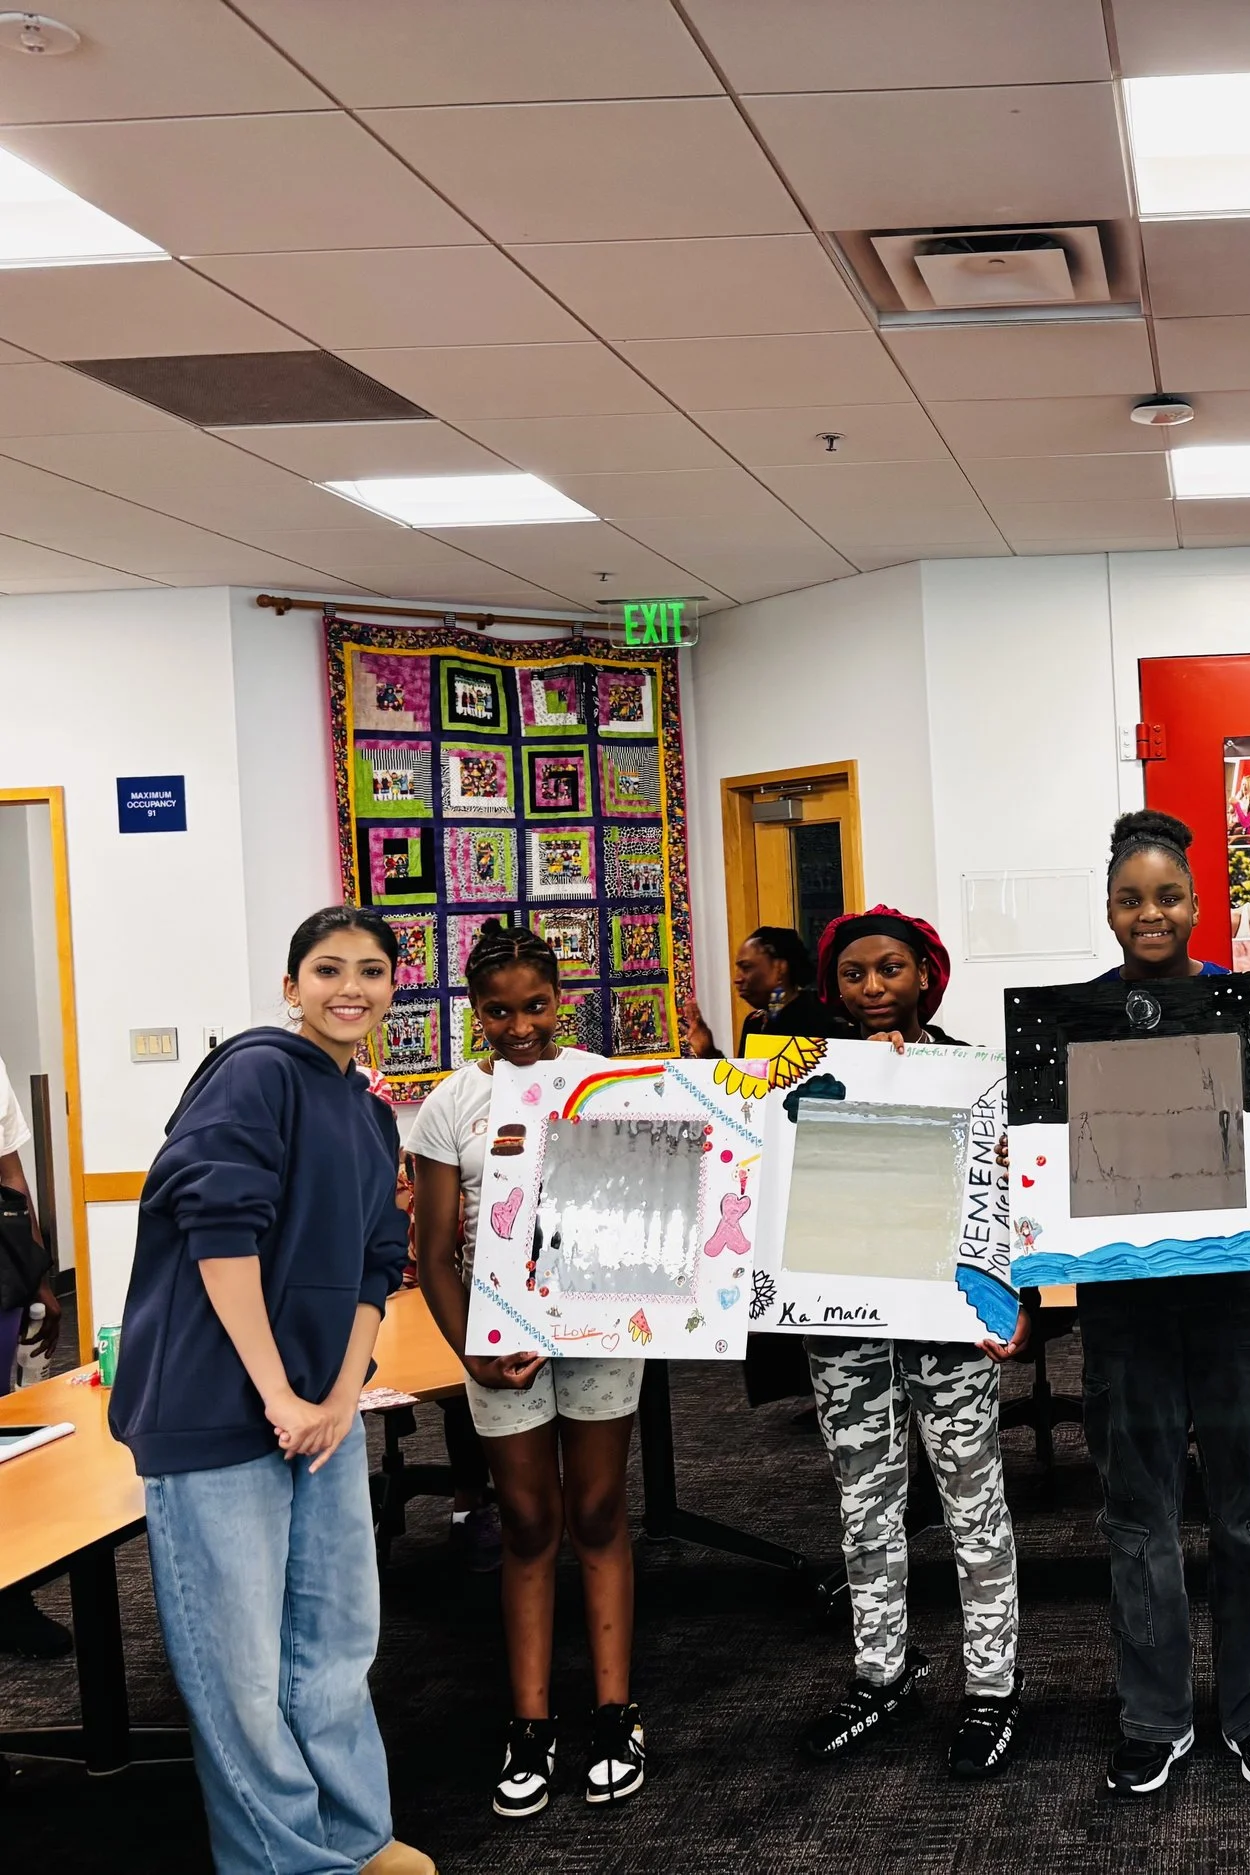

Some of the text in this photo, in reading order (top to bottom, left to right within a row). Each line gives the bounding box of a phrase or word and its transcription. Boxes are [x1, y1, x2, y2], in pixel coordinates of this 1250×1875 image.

[624, 603, 685, 645] EXIT
[126, 800, 177, 809] OCCUPANCY
[130, 791, 172, 800] MAXIMUM
[959, 1099, 996, 1259] REMEMBER
